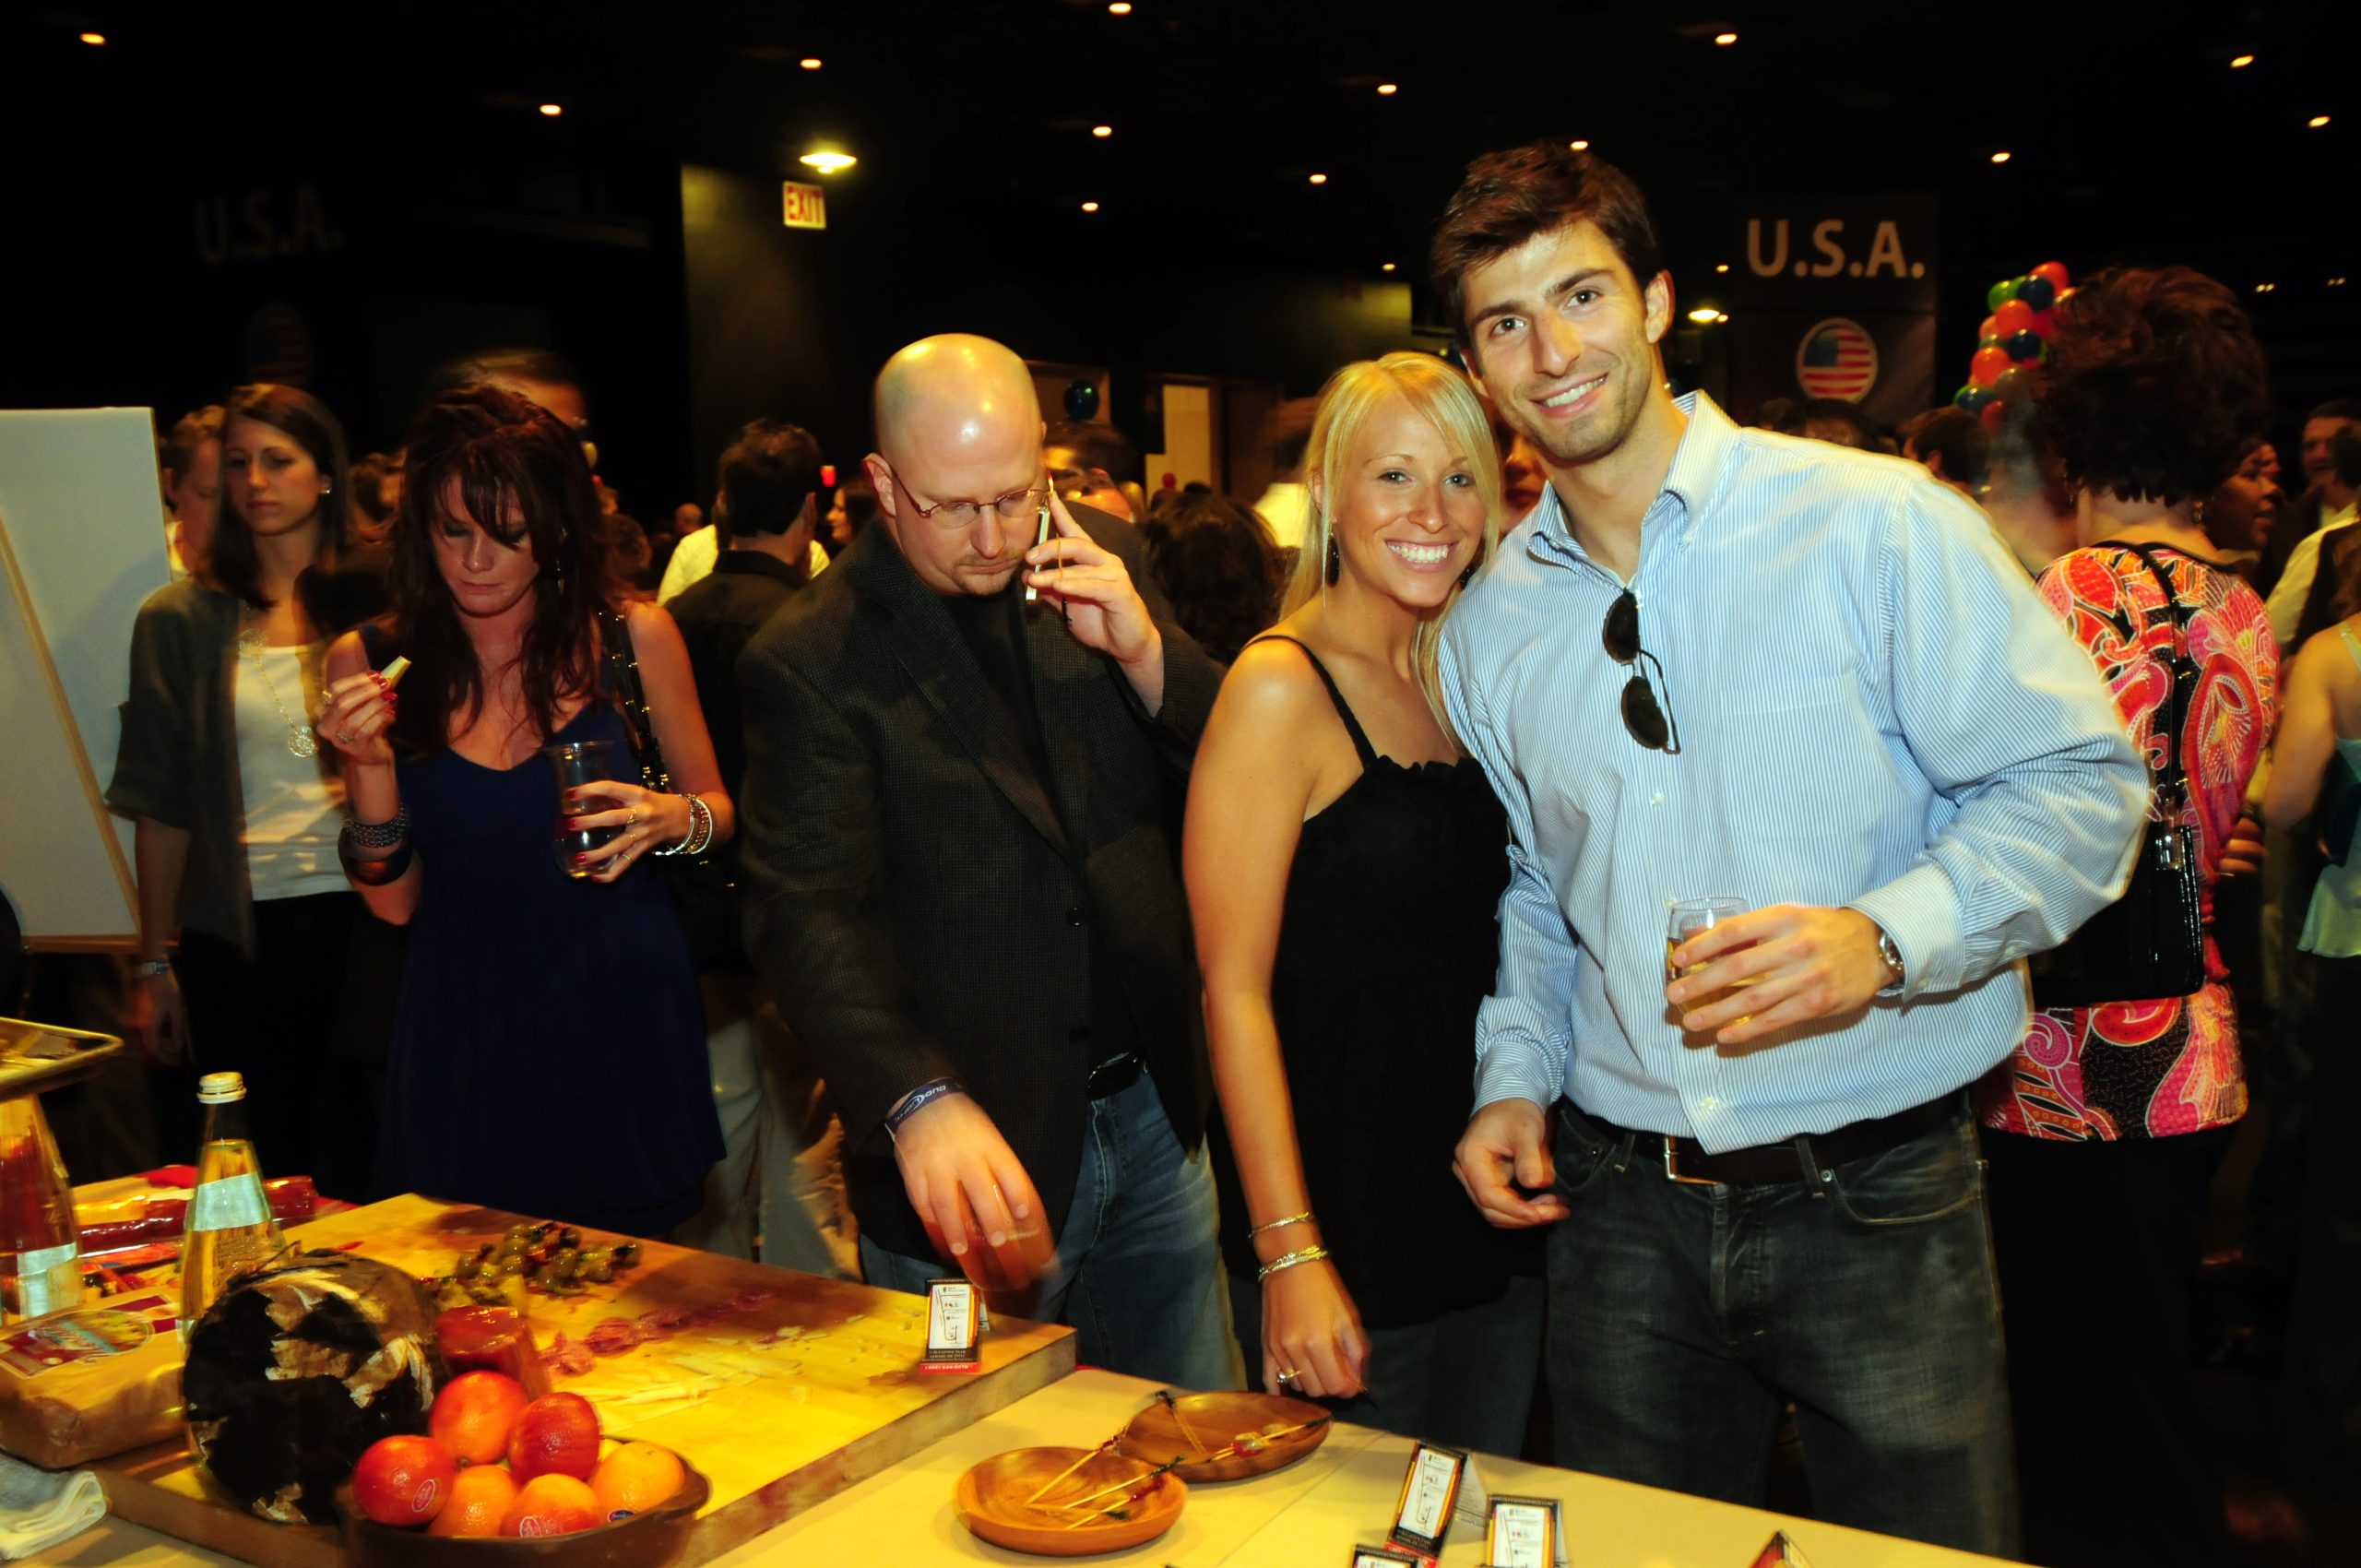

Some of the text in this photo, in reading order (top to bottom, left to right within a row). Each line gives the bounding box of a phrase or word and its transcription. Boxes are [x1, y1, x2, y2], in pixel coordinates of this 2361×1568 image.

[192, 181, 347, 266] U.S.A.
[787, 185, 822, 223] EXIT
[1746, 218, 1928, 279] U.S.A.
[925, 1085, 946, 1097] BUD
